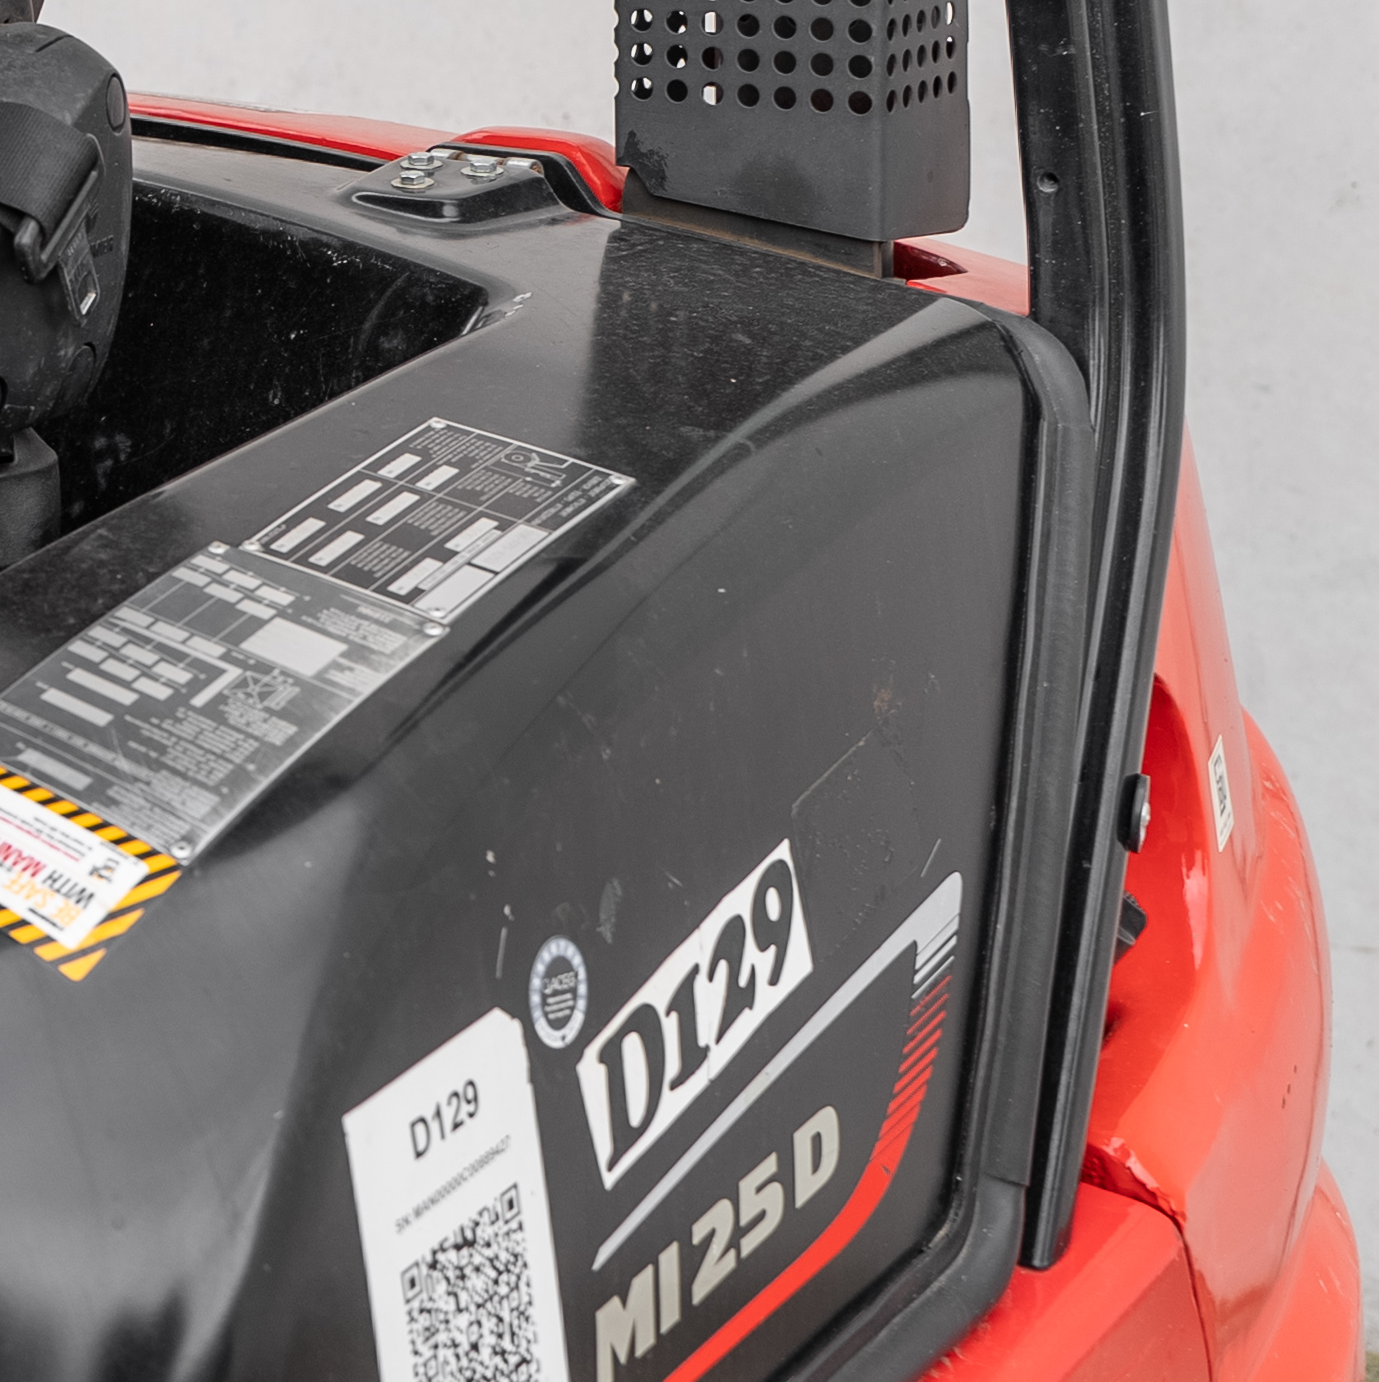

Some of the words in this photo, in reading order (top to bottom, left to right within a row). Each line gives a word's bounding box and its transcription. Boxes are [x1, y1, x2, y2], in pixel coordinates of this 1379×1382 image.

[1, 871, 56, 910] SAFE
[42, 869, 96, 910] WITH
[49, 898, 82, 927] BE
[409, 1078, 480, 1161] D129
[595, 1240, 681, 1382] MI
[691, 1151, 785, 1306] 25
[792, 1105, 840, 1209] D
